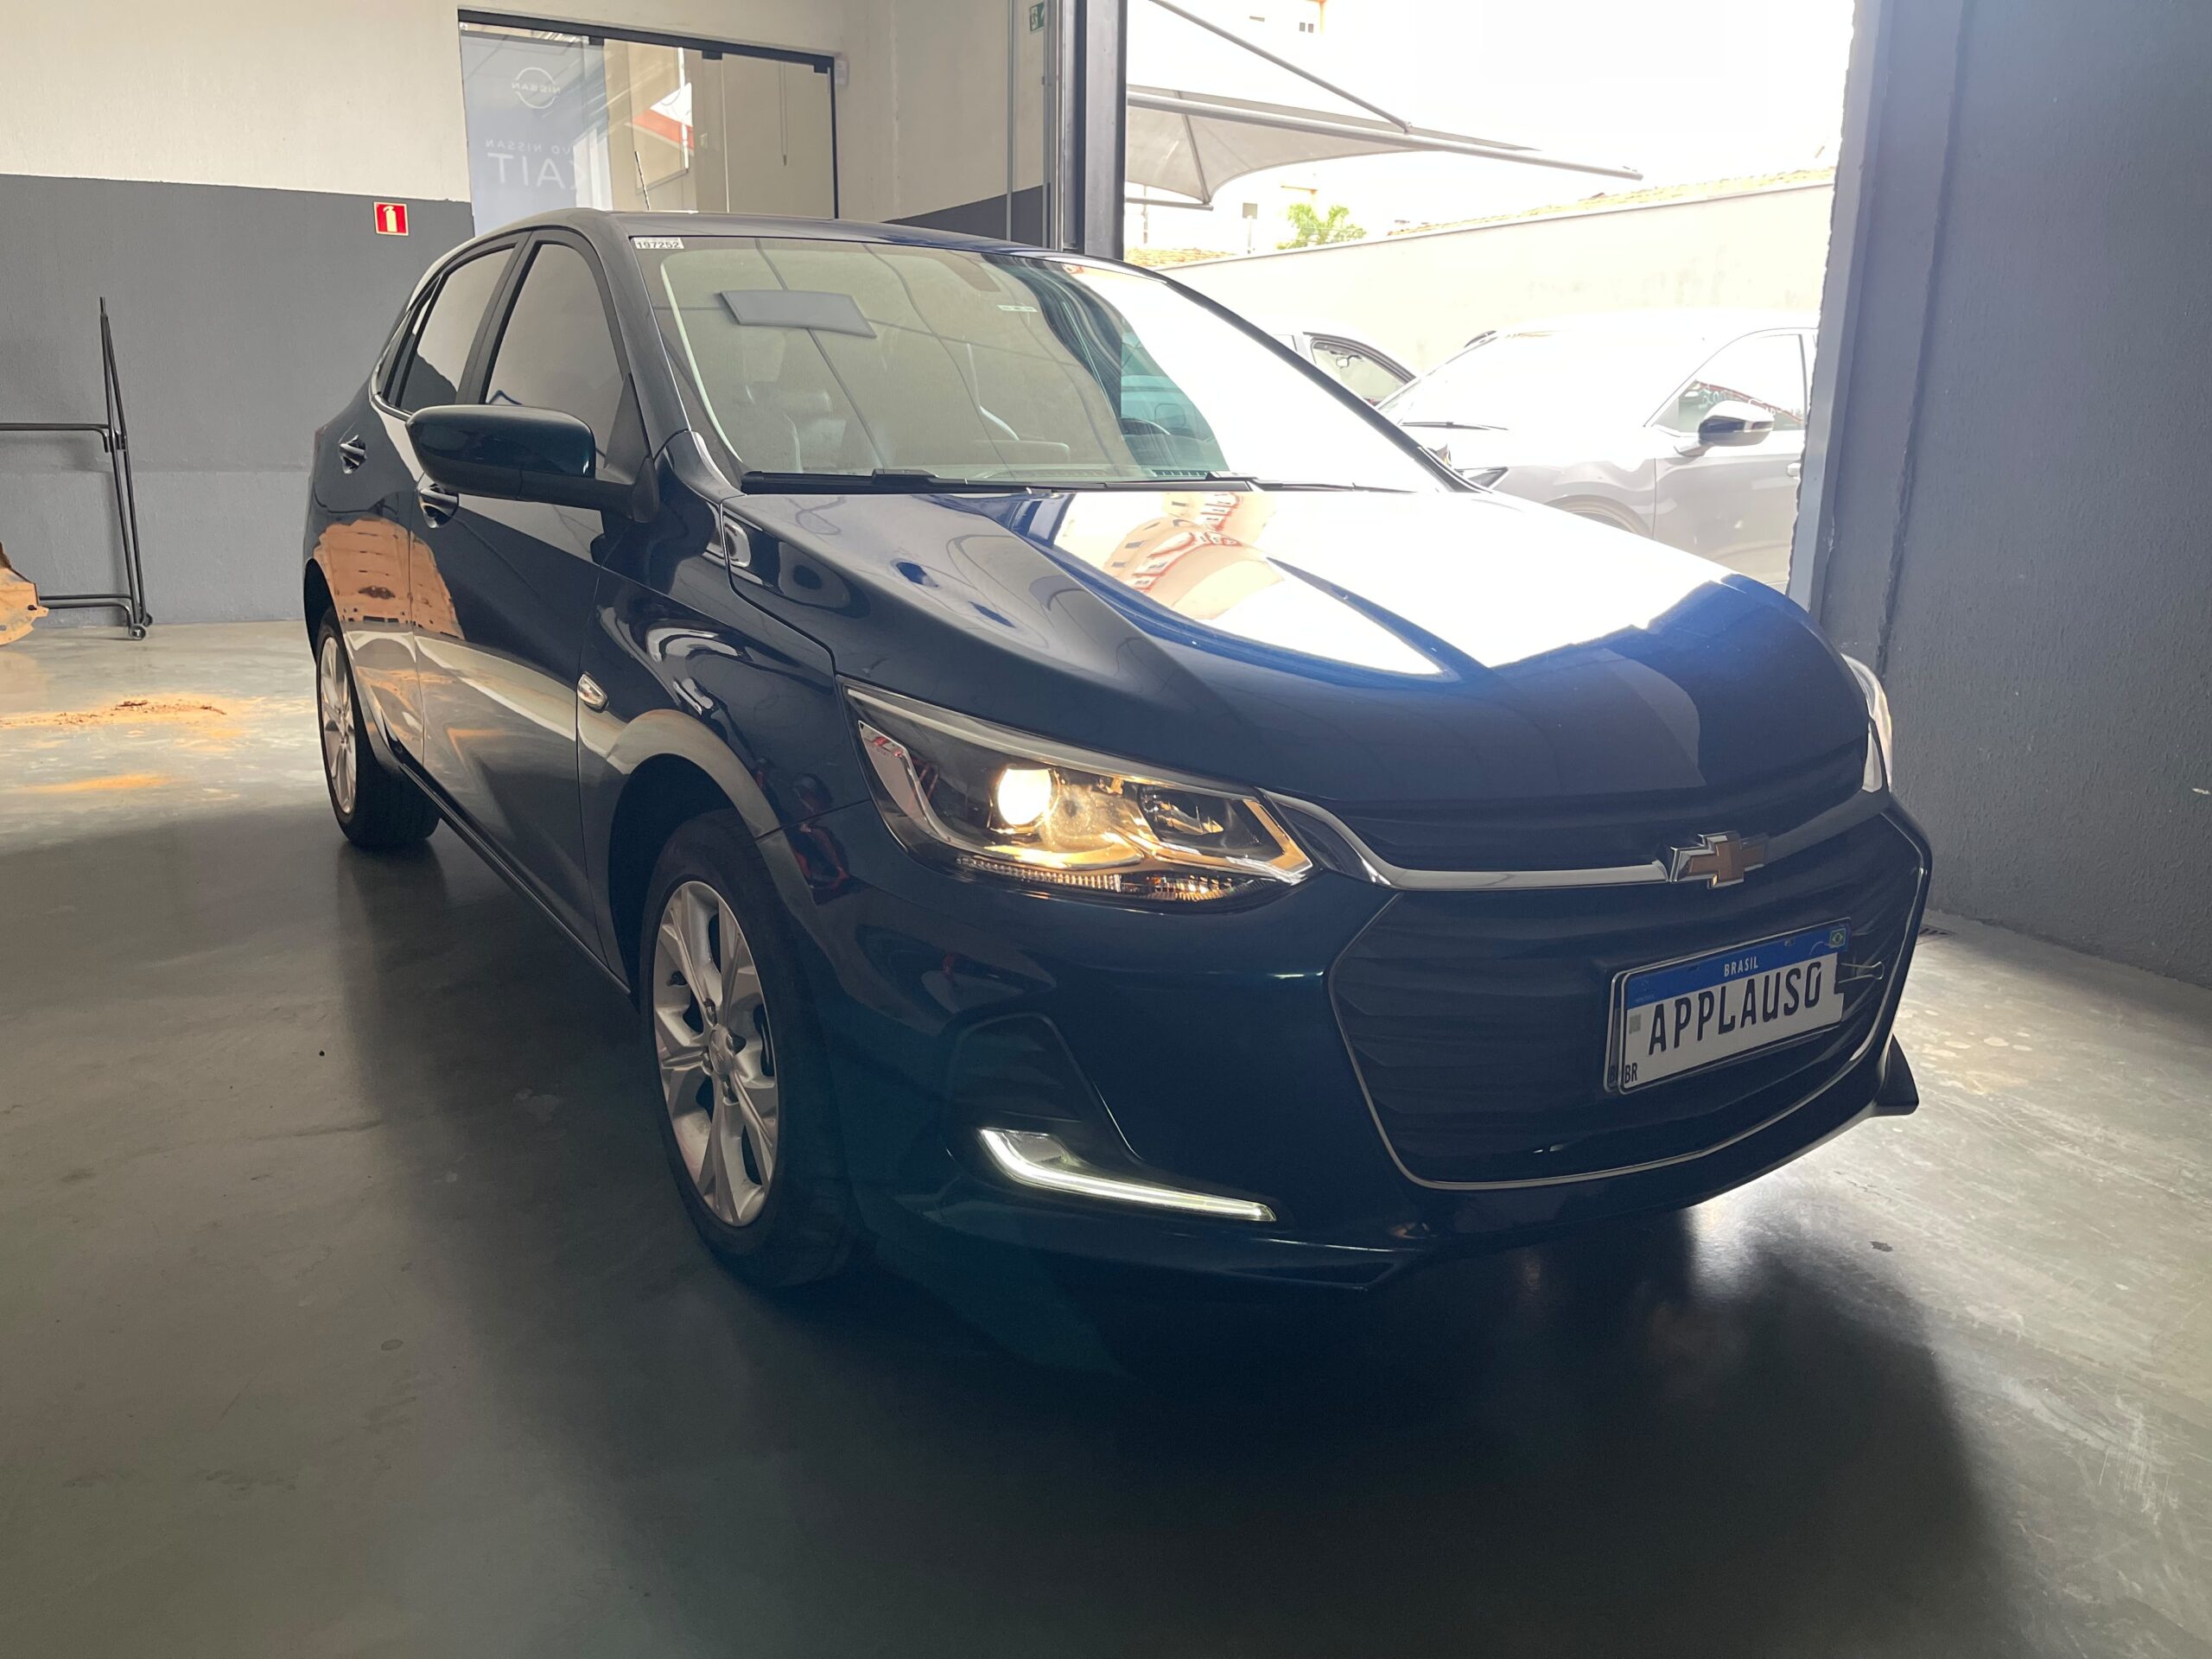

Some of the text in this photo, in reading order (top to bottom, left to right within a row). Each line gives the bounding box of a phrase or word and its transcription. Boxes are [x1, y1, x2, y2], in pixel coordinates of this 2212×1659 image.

[1724, 957, 1758, 976] BRASIL
[1649, 962, 1821, 1055] APPLAUSO
[1624, 1063, 1637, 1084] BR
